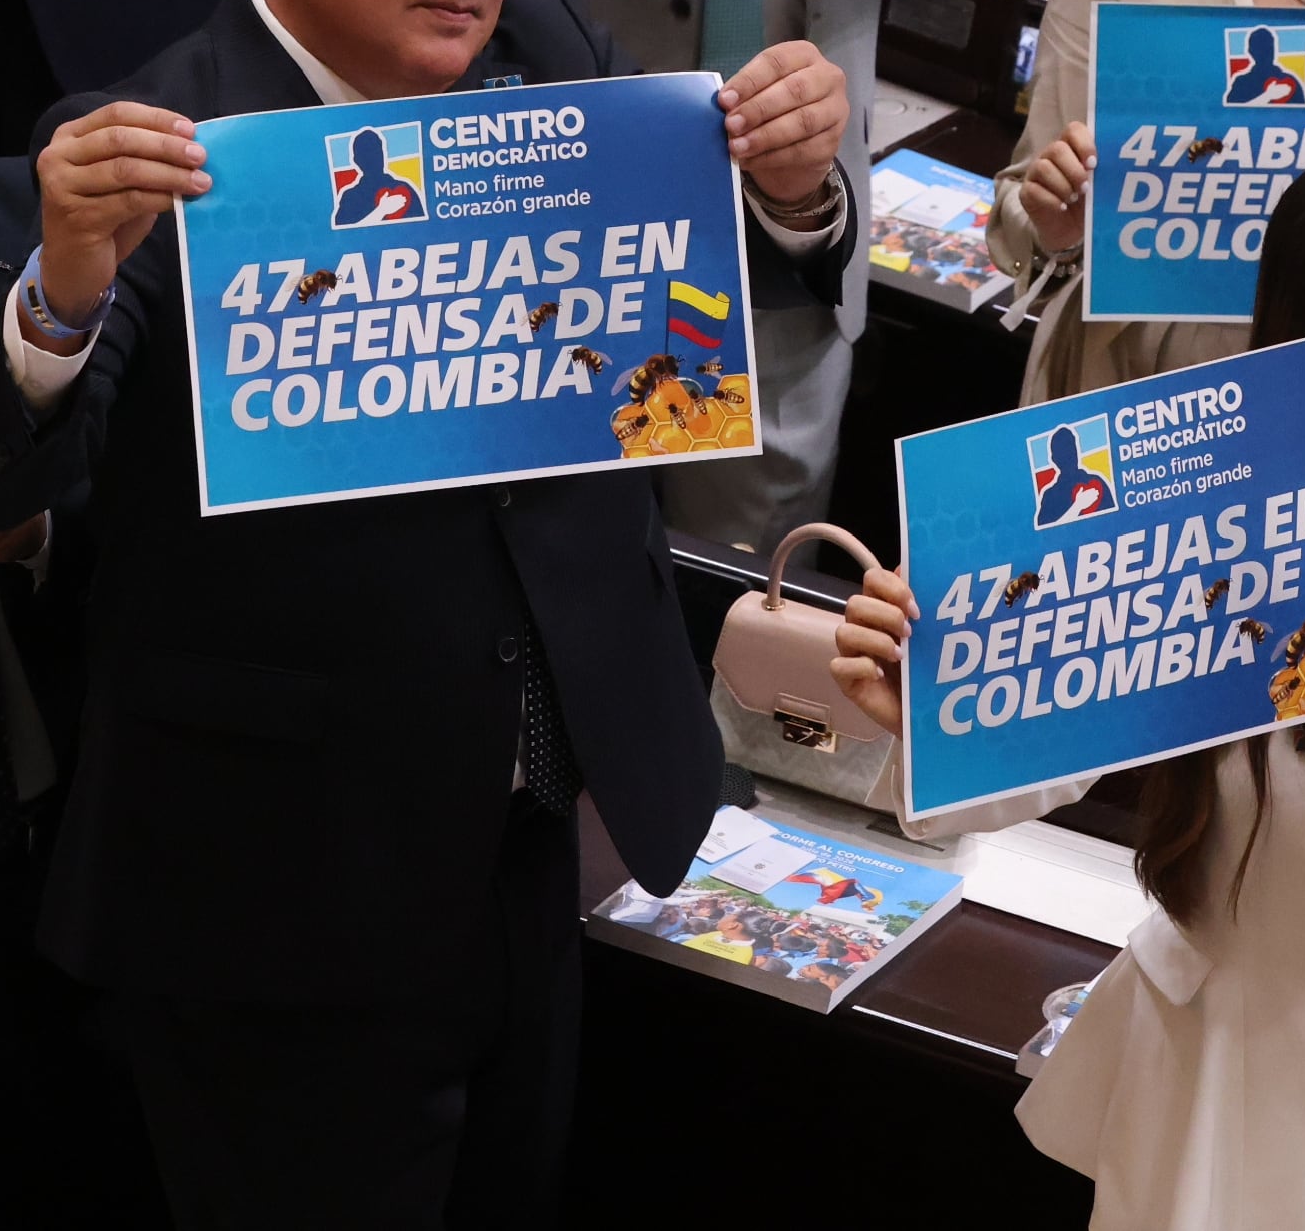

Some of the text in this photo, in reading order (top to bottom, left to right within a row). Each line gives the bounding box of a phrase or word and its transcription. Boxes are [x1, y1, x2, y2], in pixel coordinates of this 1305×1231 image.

[429, 105, 584, 150] CENTRO
[1119, 125, 1196, 167] 47
[433, 141, 587, 172] DEMOCRÁTICO
[434, 173, 544, 199] Mano firme
[436, 189, 590, 219] Corazón grande
[1117, 172, 1295, 216] DEFE
[1118, 218, 1268, 262] COLO
[221, 219, 690, 316] 47 ABEJAS EN
[226, 280, 645, 375] DEFENSA DE
[230, 343, 594, 432] COLOMBIA
[1115, 380, 1243, 438] CENTRO
[1119, 415, 1246, 462] DEMOCRÁTICO
[1122, 451, 1213, 487] Mano firme
[1124, 463, 1252, 508] Corazón grande
[935, 564, 1011, 626] 47
[1024, 504, 1247, 608] ABEJAS
[935, 548, 1302, 685] DEFENSA DE
[938, 617, 1256, 736] COLOMBIA
[817, 844, 833, 853] AL
[837, 850, 904, 873] CONGRESO
[827, 860, 856, 873] PETRO
